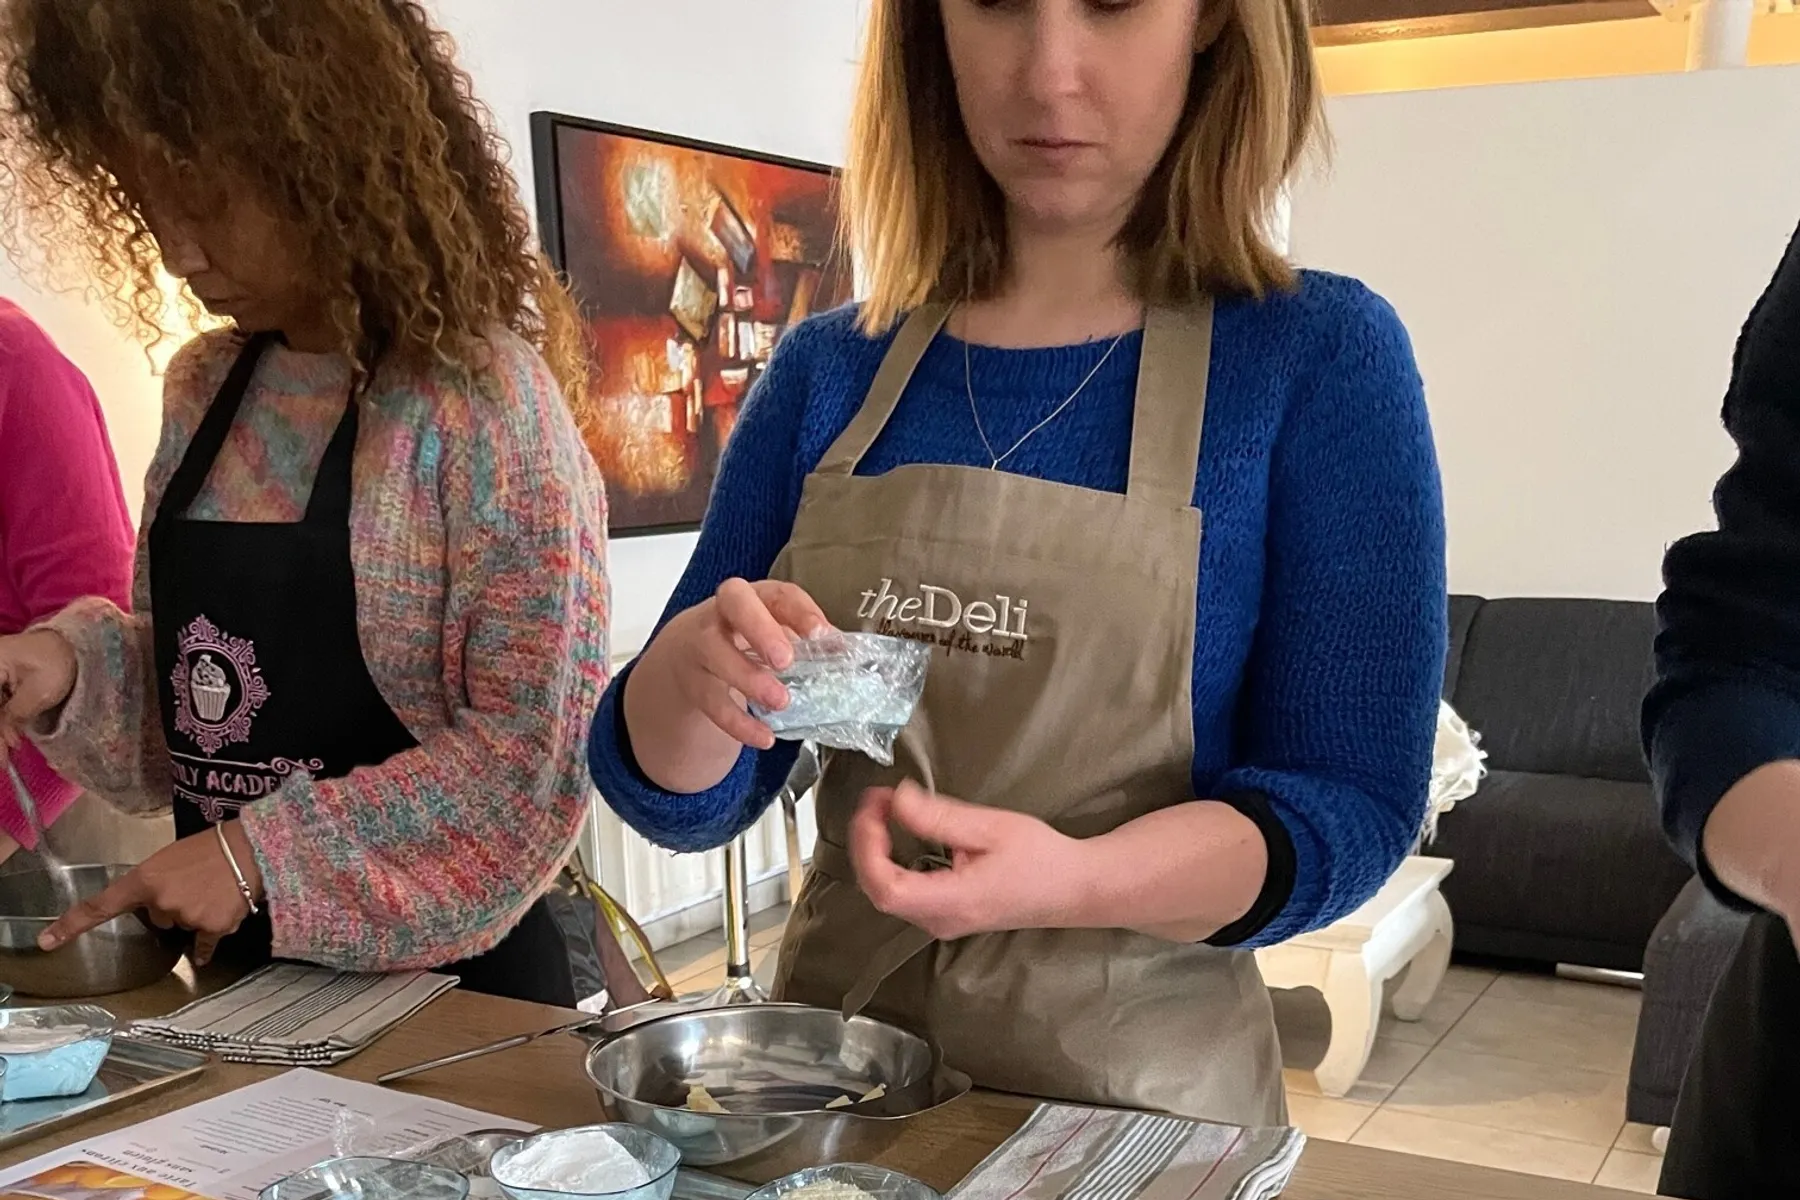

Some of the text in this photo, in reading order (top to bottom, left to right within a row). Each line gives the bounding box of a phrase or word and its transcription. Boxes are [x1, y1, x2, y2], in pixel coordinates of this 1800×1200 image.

[857, 577, 1028, 640] theDeli
[958, 631, 978, 654] the
[206, 769, 281, 796] ACADE
